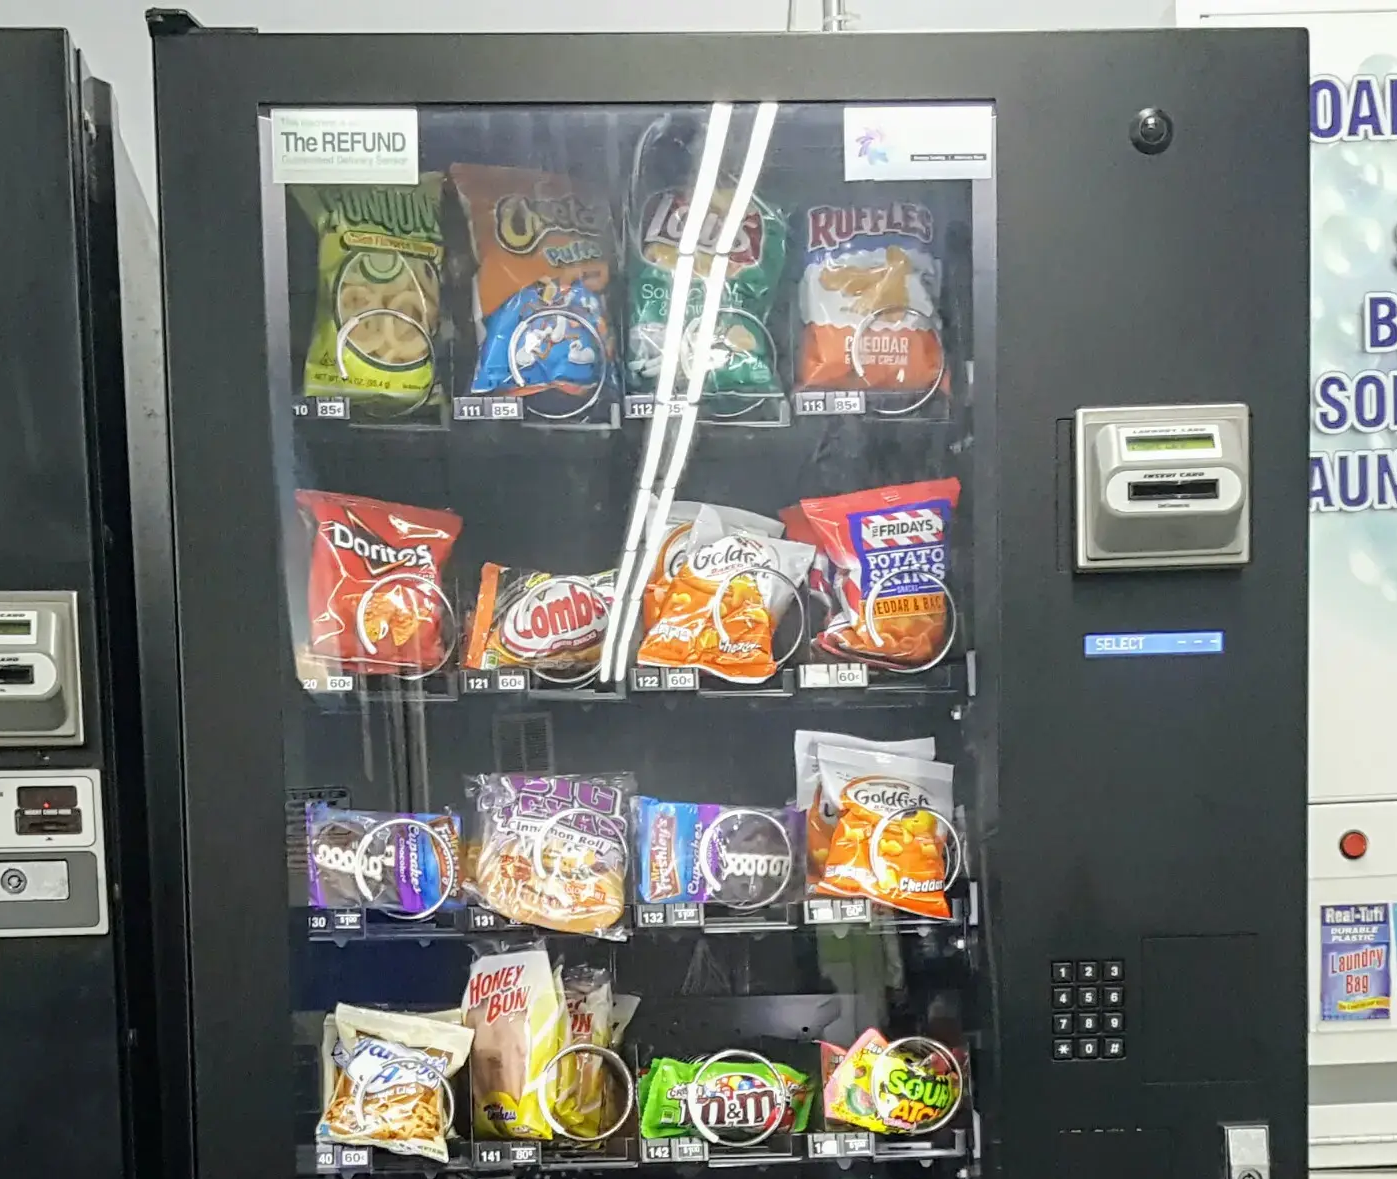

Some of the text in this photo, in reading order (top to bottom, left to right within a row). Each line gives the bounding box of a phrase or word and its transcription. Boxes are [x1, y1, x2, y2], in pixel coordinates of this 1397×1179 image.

[281, 131, 407, 153] The REFUND
[808, 204, 934, 252] RUFFLES
[857, 355, 909, 366] OUR CREAM
[320, 404, 343, 416] 85¢
[462, 405, 517, 416] 111 85¢
[632, 403, 653, 415] 112
[803, 401, 824, 412] 113
[879, 519, 933, 537] FRIDAYS
[333, 523, 433, 568] Doritos
[866, 547, 945, 569] POTATO
[870, 563, 946, 588] SKINS
[1096, 637, 1146, 650] SELECT
[303, 679, 318, 690] 20
[468, 677, 523, 690] 121 60¢
[638, 674, 692, 687] 122 60¢
[853, 788, 929, 809] Goldfish
[577, 833, 606, 850] Roll
[475, 915, 495, 926] 131
[644, 912, 664, 923] 132
[1326, 906, 1384, 924] Real-Tuff
[1330, 926, 1379, 935] DURABLE
[1332, 933, 1375, 942] PLASTIC
[1330, 947, 1384, 975] Laundry
[1059, 966, 1119, 978] 1 2 3
[469, 964, 525, 1008] HONEY
[1345, 974, 1370, 994] Bag
[1059, 992, 1119, 1003] 4 5 6
[486, 985, 531, 1025] BUN
[1059, 1017, 1119, 1030] 7 8 9
[1085, 1043, 1093, 1054] 0
[887, 1070, 952, 1107] SOUR
[319, 1152, 333, 1164] 40
[481, 1151, 501, 1162] 141
[649, 1147, 670, 1158] 142
